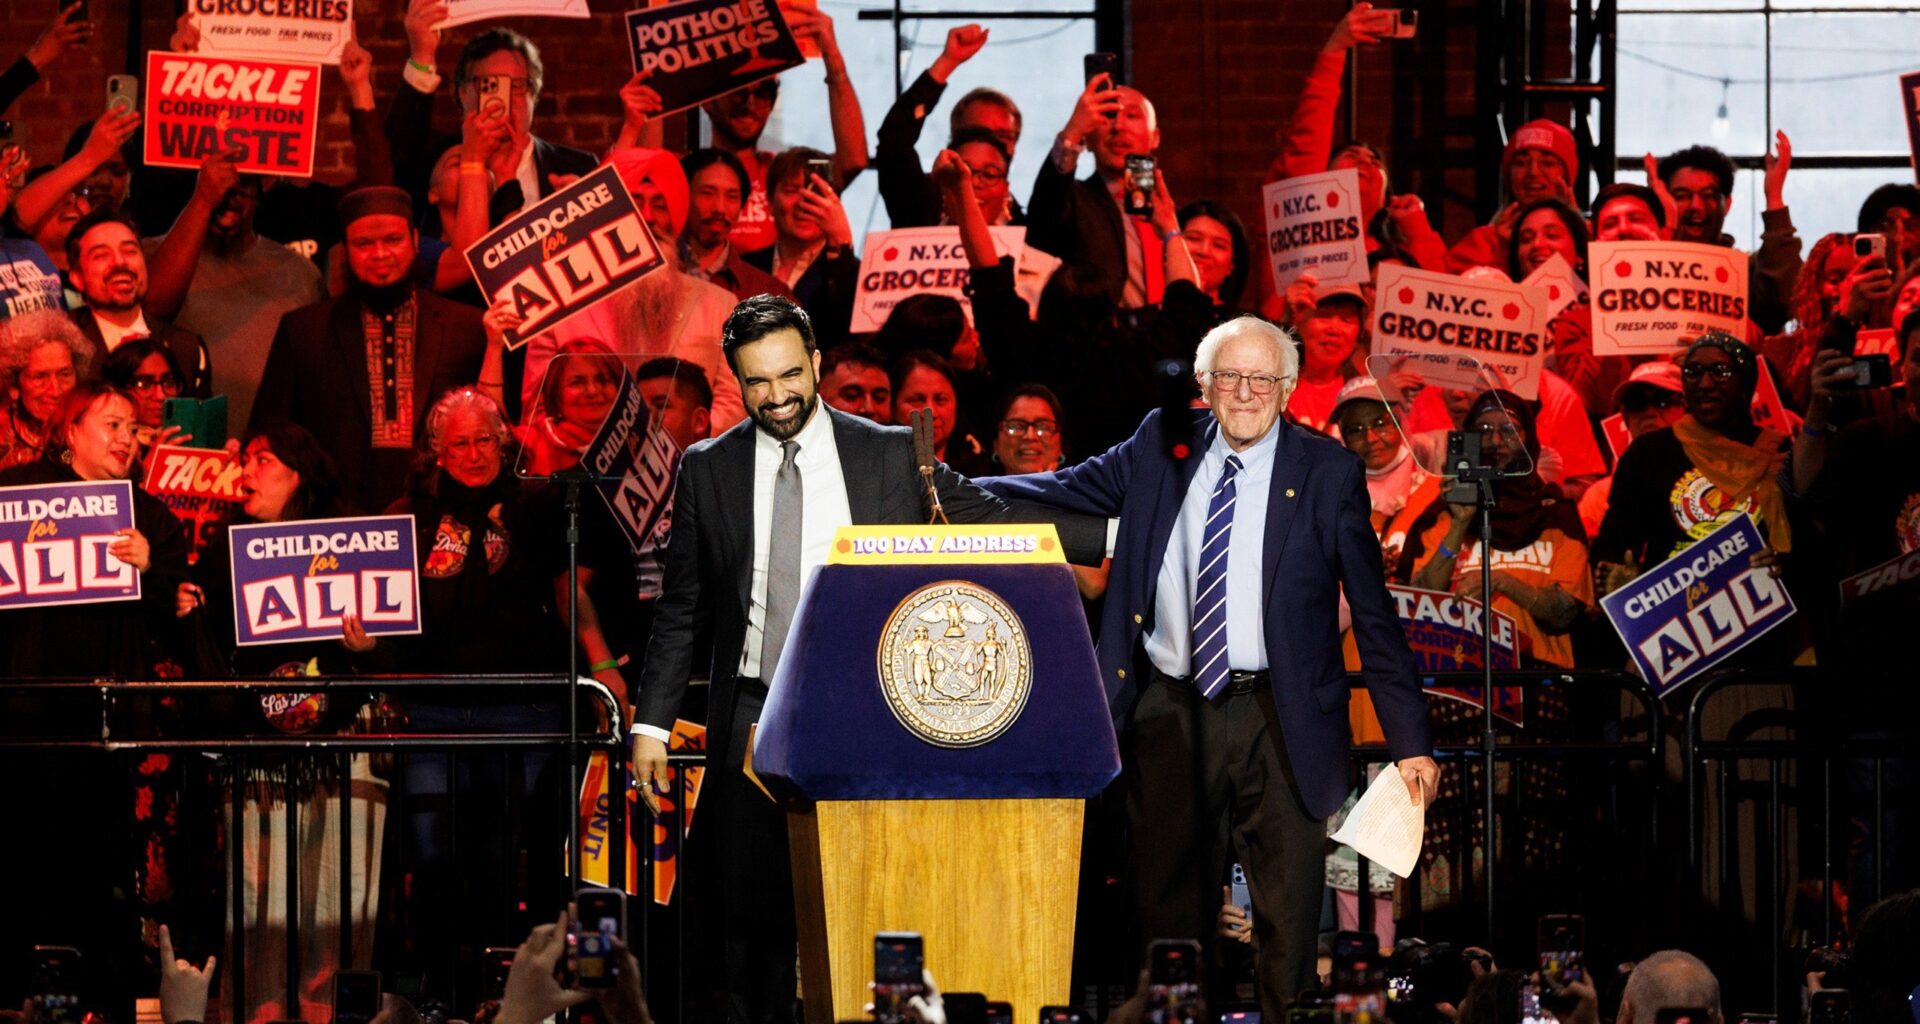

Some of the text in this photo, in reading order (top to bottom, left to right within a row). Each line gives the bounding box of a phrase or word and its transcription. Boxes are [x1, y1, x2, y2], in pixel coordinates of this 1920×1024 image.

[195, 0, 349, 23] GROCERIES
[636, 0, 769, 50] POTHOLE
[211, 26, 333, 41] FRESH FOOD FAIR PRICES
[640, 20, 779, 73] POLITICS
[161, 60, 311, 106] TACKLE
[158, 98, 305, 125] CORRUPTION
[158, 121, 302, 167] WASTE
[1283, 194, 1321, 218] N.Y.C.
[482, 182, 614, 270] CHILDCARE
[1270, 215, 1360, 255] GROCERIES
[541, 230, 568, 262] for
[909, 244, 966, 261] N.Y.C
[512, 225, 643, 321] ALL
[863, 267, 970, 292] GROCER
[1644, 260, 1709, 282] N.Y.C.
[1426, 291, 1493, 319] N.Y.C.
[1597, 286, 1745, 320] GROCERIES
[1379, 311, 1540, 357] GROCERIES
[1614, 321, 1648, 332] FRESH
[1651, 321, 1678, 331] FOOD
[1685, 321, 1705, 331] FAIR
[1423, 354, 1450, 365] FOOD
[1456, 357, 1479, 369] FAIR
[1482, 362, 1518, 375] PCES
[158, 454, 243, 497] TACK
[27, 520, 58, 543] for
[246, 530, 400, 560] CHILDCARE
[853, 535, 1037, 555] 100 DAY ADDRESS
[308, 554, 338, 577] for
[1624, 531, 1749, 619] CHILDCARE
[255, 576, 402, 628] ALL
[1686, 580, 1709, 610] for
[1390, 589, 1514, 651] TACKLE
[1658, 573, 1774, 682] ALL
